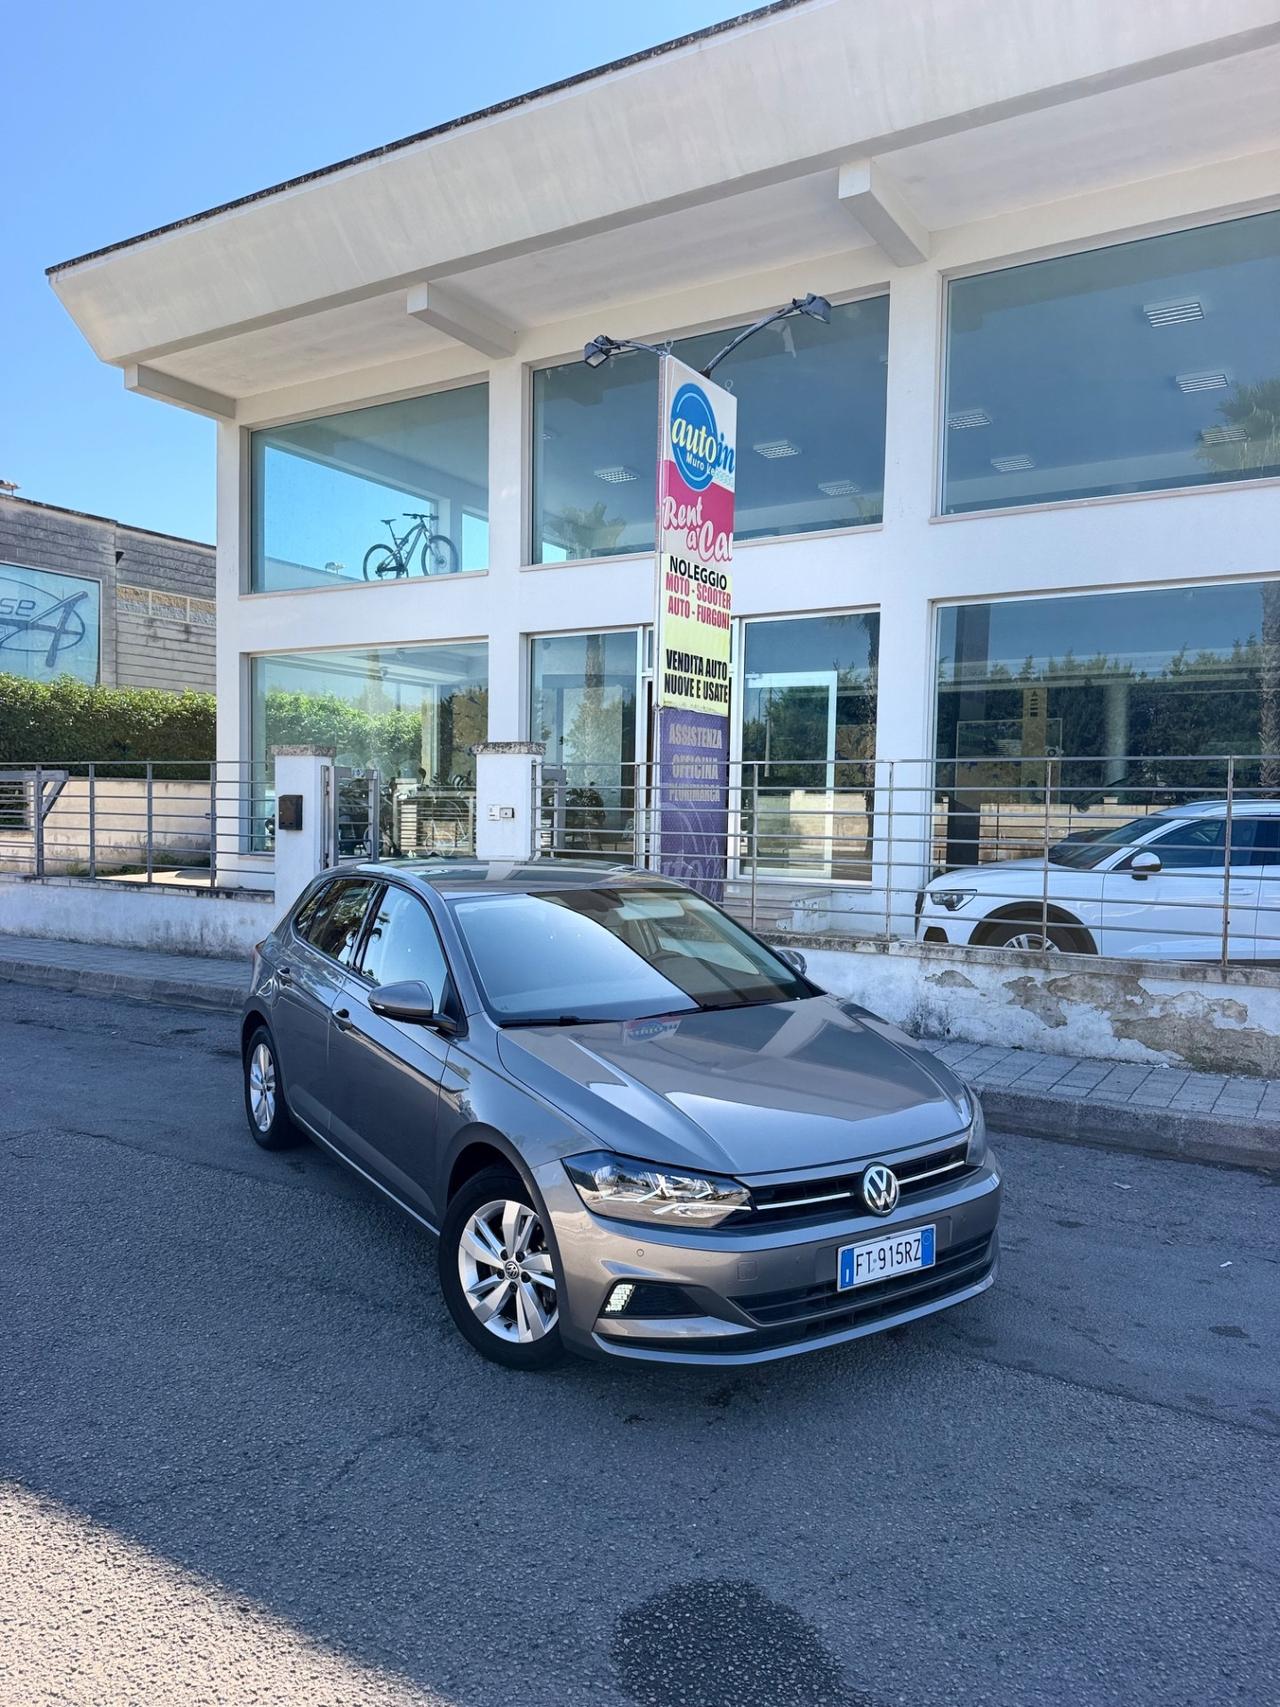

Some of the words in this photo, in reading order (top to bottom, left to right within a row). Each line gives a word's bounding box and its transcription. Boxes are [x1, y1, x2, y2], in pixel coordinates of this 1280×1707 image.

[686, 452, 705, 471] Muro
[663, 496, 703, 529] Rent
[687, 527, 700, 551] a
[670, 555, 728, 591] NOLEGGIO
[665, 572, 690, 597] MOTO
[696, 583, 732, 610] SCOOTER
[668, 595, 691, 619] AUTO
[696, 604, 730, 631] FURGONI
[666, 648, 704, 677] VENDITA
[705, 658, 728, 681] AUTO
[664, 672, 694, 698] NUOVE
[696, 680, 701, 699] E
[703, 681, 728, 704] USATE
[669, 723, 723, 749] ASSISTENZA
[672, 753, 719, 780] OFFICINA
